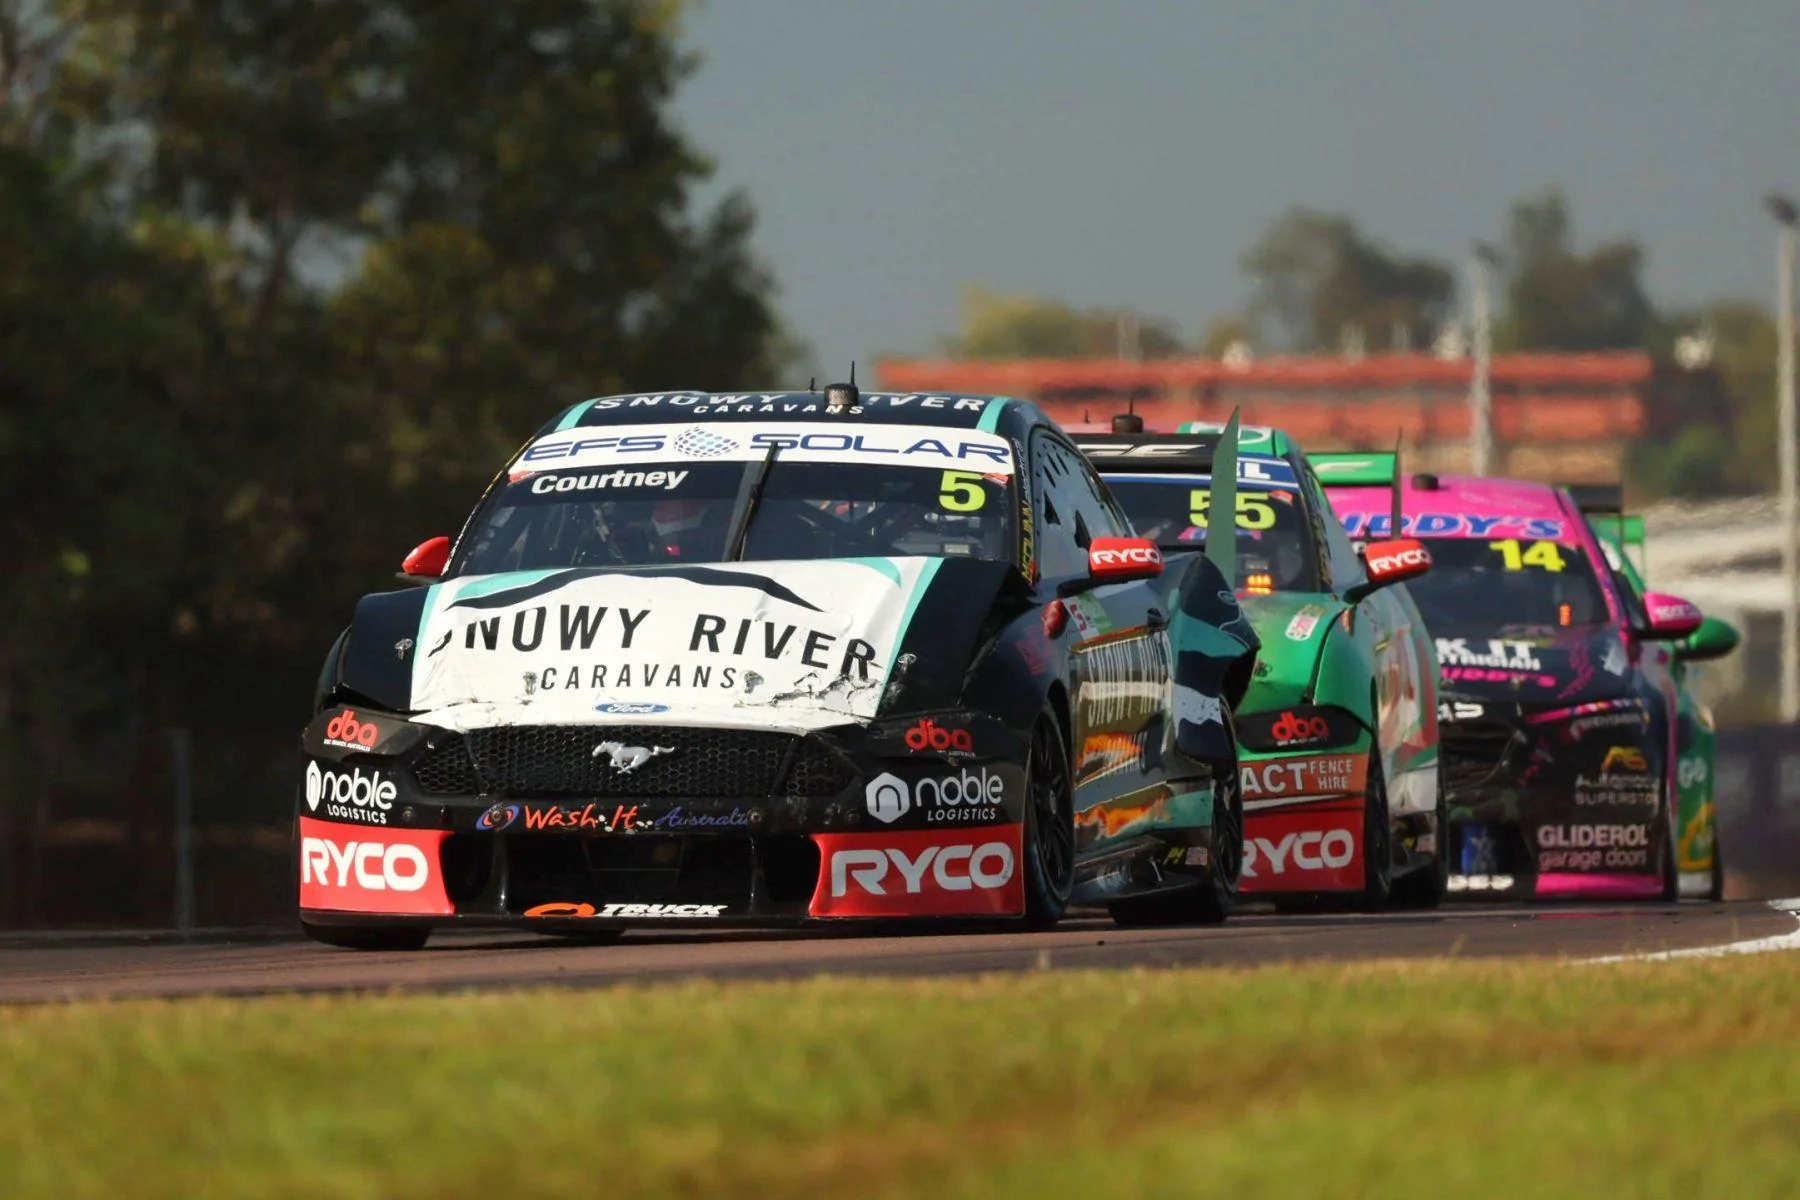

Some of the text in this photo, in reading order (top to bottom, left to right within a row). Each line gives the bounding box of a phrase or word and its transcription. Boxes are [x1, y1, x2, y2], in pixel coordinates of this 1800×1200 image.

[594, 394, 985, 411] SNOWY IVER
[693, 405, 865, 415] CARAVANS
[523, 433, 1011, 464] EFS SOLAR
[531, 470, 688, 495] Courtney
[938, 470, 987, 512] 5
[1189, 490, 1276, 530] 55
[1091, 547, 1160, 566] RYCO
[1369, 551, 1431, 576] RYCO
[1489, 539, 1567, 572] 14
[689, 613, 883, 682] RIVER
[540, 664, 737, 690] CARAVANS
[606, 702, 656, 714] Ford
[327, 709, 378, 748] dba
[904, 718, 973, 752] dba
[1272, 711, 1329, 742] dba
[1240, 762, 1307, 794] ACT
[1310, 759, 1353, 774] FENCE
[321, 768, 397, 810] noble
[915, 767, 1004, 808] noble
[1318, 776, 1349, 790] HIRE
[327, 804, 387, 825] LOGISTICS
[524, 803, 597, 829] Wash
[612, 804, 641, 829] It
[927, 808, 997, 822] LOGISTICS
[1537, 824, 1649, 848] GLIDEROL
[302, 836, 429, 892] RYCO
[1241, 829, 1353, 877] RYCO
[1538, 851, 1600, 871] garage
[831, 841, 1015, 898] RYCO
[597, 903, 728, 917] TRUCK
